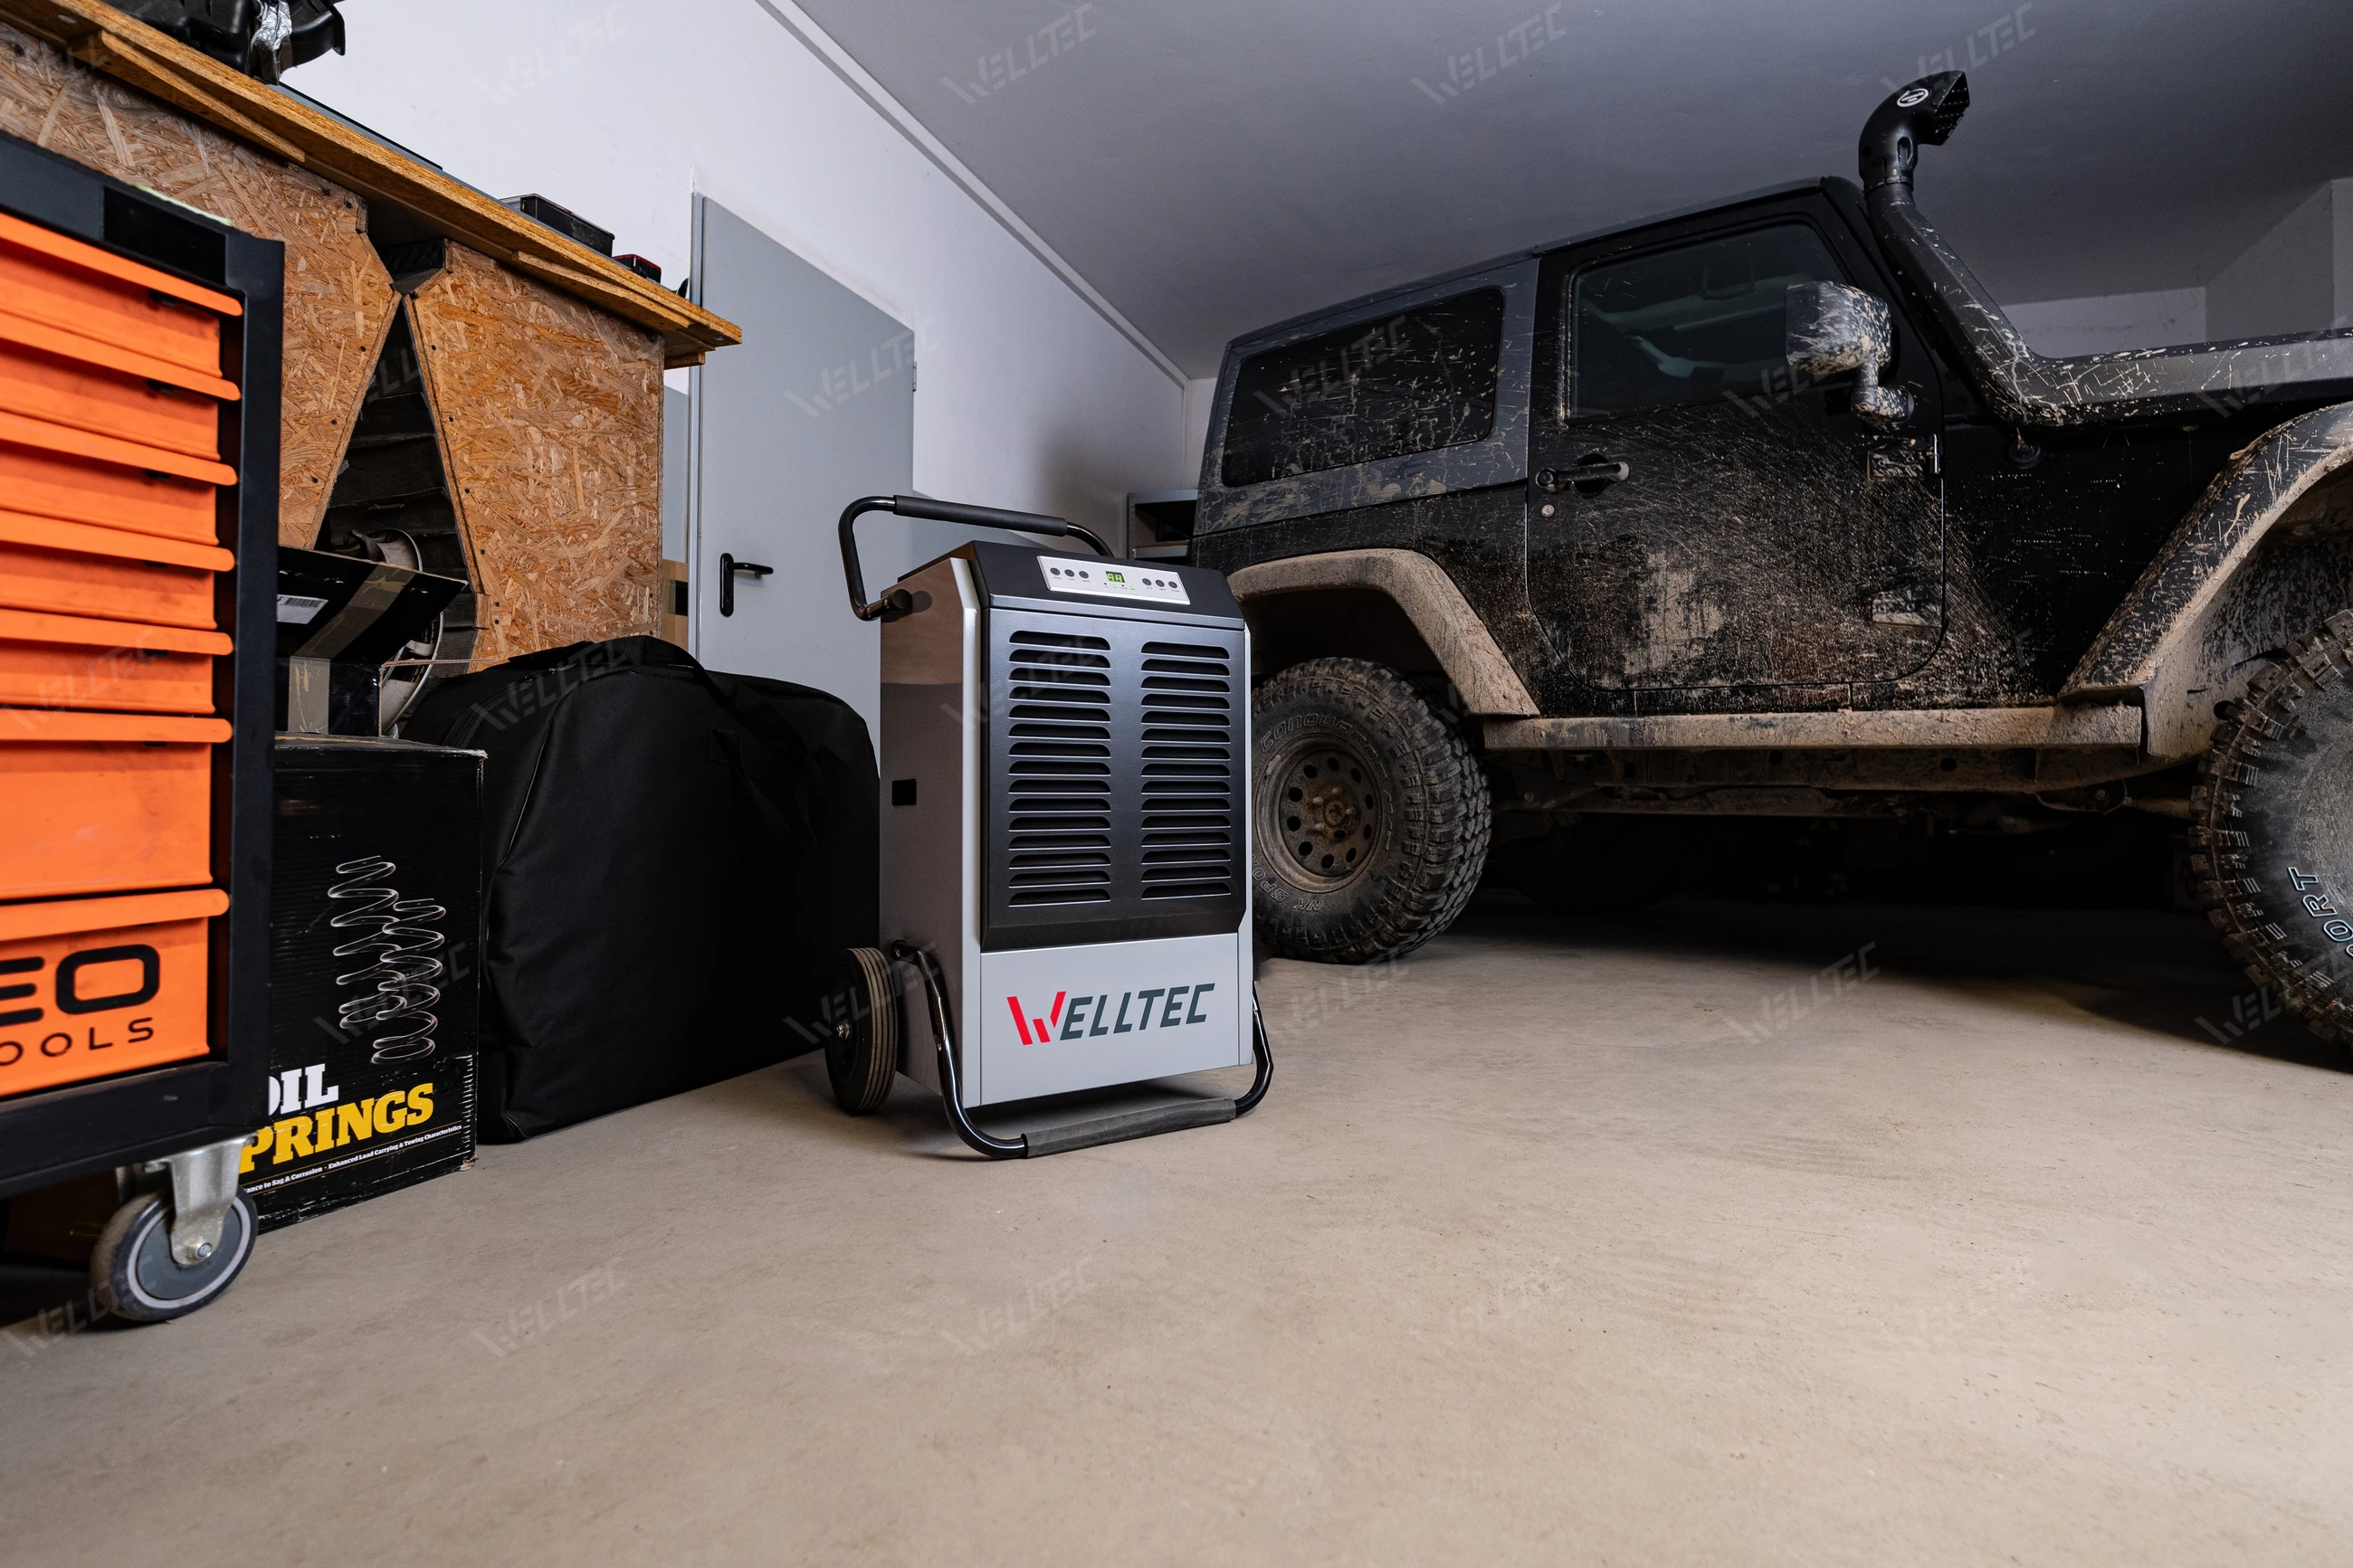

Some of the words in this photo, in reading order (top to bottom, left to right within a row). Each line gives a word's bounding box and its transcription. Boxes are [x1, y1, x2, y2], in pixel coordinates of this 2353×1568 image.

[2288, 867, 2353, 957] ORT
[1006, 983, 1215, 1045] WELLTEC
[239, 1082, 434, 1174] PRINGS
[245, 1183, 263, 1194] ance
[272, 1177, 284, 1187] Sag
[291, 1166, 323, 1181] Corrosion
[328, 1155, 358, 1170] Enhanced
[358, 1151, 374, 1161] Load
[374, 1144, 399, 1156] Carrying
[404, 1136, 424, 1147] Towing
[424, 1125, 462, 1141] Characteristics
